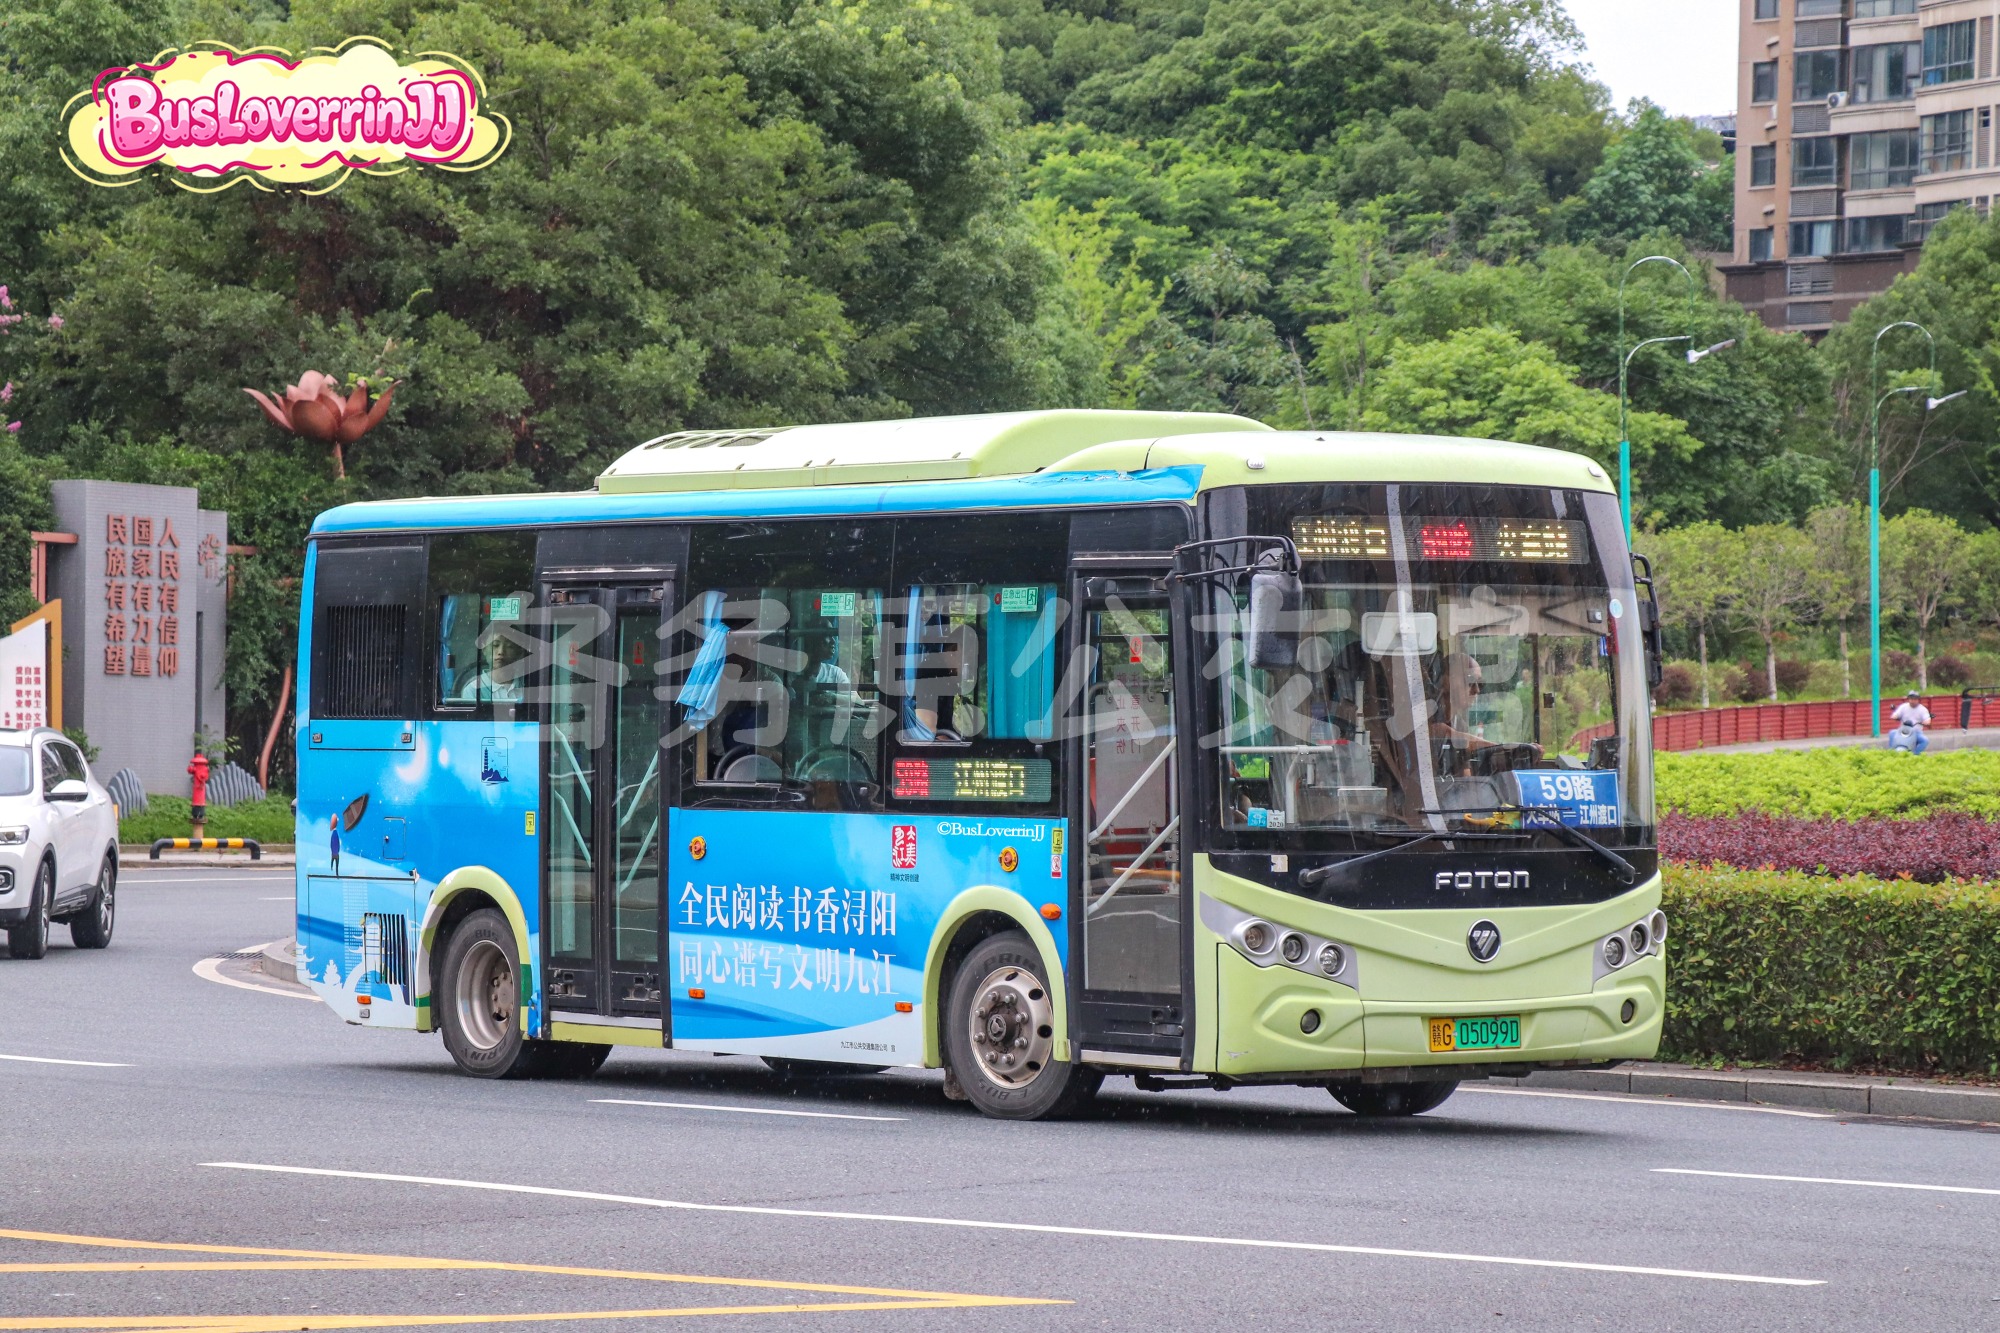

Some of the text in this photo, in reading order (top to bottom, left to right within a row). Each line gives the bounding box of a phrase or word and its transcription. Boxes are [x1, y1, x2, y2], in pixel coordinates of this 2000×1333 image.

[105, 513, 127, 677] 民族有希望
[131, 515, 153, 678] 国家有力量
[157, 517, 180, 679] 人民有信仰
[1539, 774, 1596, 802] 59路
[1579, 804, 1617, 825] 江州渡口
[890, 873, 920, 883] 精神文明创建
[1435, 870, 1530, 890] FOTON
[678, 881, 898, 937] 全民阅读书香浔阳
[678, 940, 899, 997] 同心谱写文明九江
[1460, 1020, 1519, 1046] 05099D
